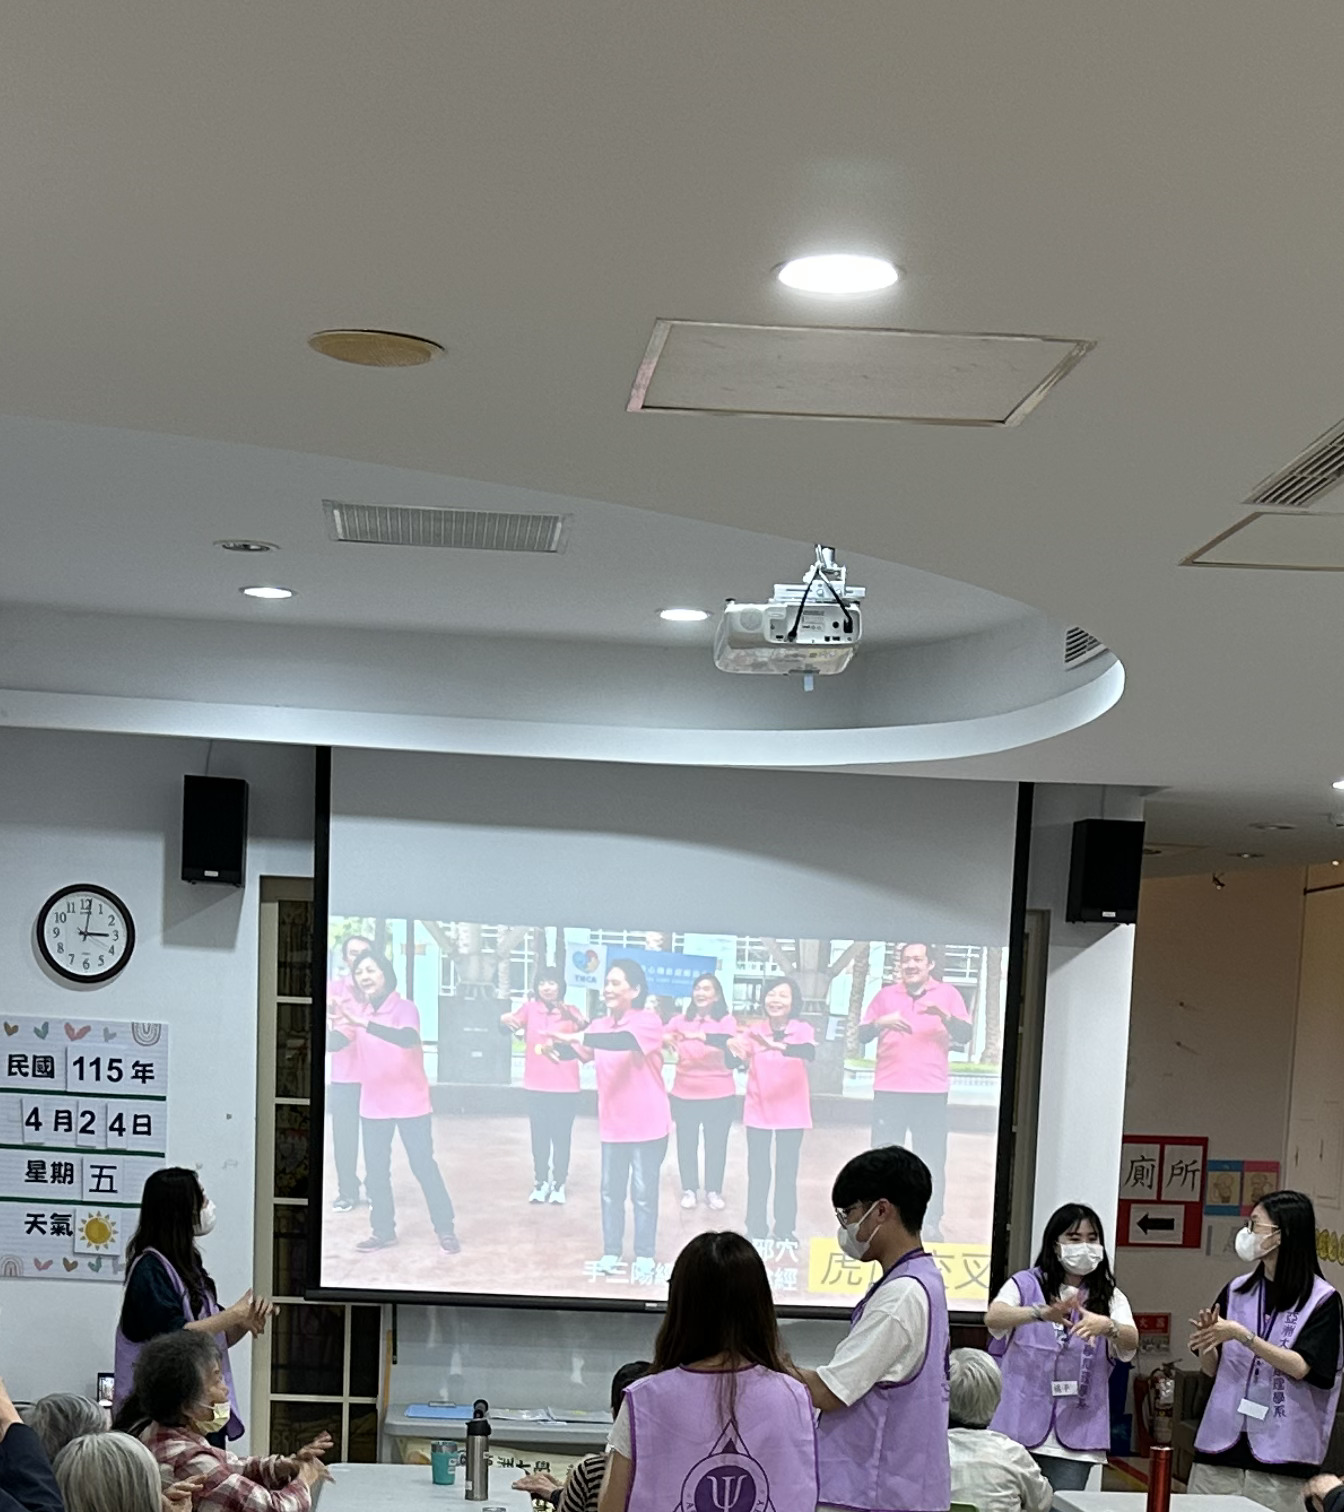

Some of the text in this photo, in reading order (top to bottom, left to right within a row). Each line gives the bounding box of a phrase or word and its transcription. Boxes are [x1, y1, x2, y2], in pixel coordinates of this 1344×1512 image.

[66, 901, 76, 914] 11
[80, 898, 92, 910] 12
[98, 903, 104, 915] 1
[54, 912, 67, 924] 10
[108, 914, 116, 927] 2
[52, 927, 60, 938] 9
[112, 929, 119, 941] 3
[57, 942, 65, 954] 8
[108, 944, 115, 956] 4
[68, 953, 75, 965] 7
[82, 958, 90, 970] 6
[98, 954, 105, 967] 5
[7, 1053, 156, 1084] 民國115年
[24, 1106, 153, 1138] 4月24日
[23, 1159, 118, 1195] 星期五
[1124, 1155, 1201, 1192] 廁所
[23, 1212, 74, 1237] 天氣
